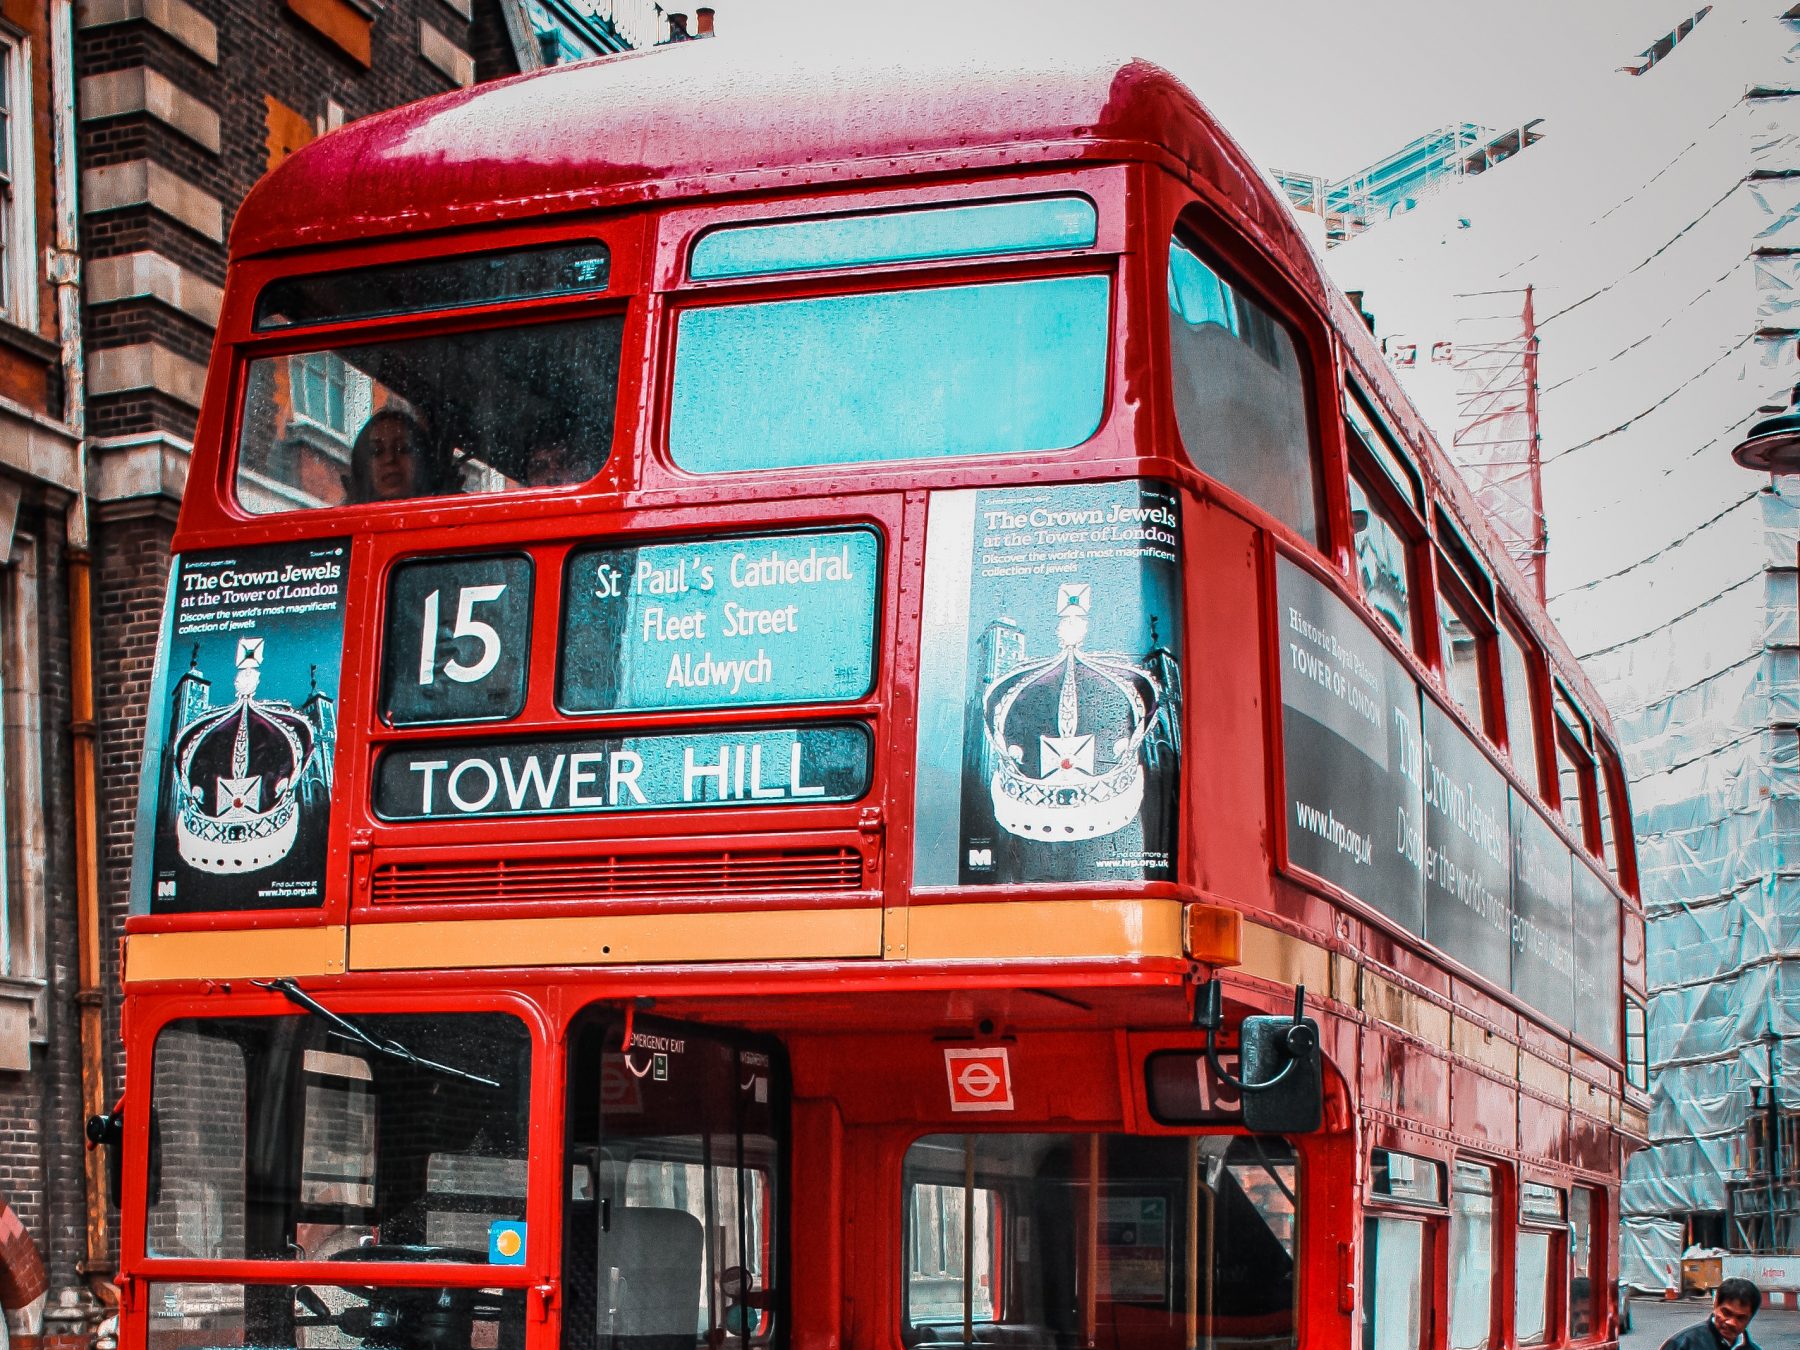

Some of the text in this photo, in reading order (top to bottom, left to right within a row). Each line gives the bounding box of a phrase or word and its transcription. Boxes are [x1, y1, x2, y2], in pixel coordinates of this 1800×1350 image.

[983, 504, 1176, 530] The Crown Jewels
[983, 526, 1176, 548] at the Tower of London
[982, 546, 1176, 565] Discover the world's most magnificent
[183, 562, 340, 592] The Crown Jewels
[595, 544, 852, 599] St Paul's Cathedral
[981, 563, 1078, 577] collection of jewels
[181, 583, 338, 608] at the Tower of London
[180, 601, 337, 623] Discover the world's most magnificent
[643, 600, 799, 642] Fleet Street
[179, 619, 255, 635] collection of jewels
[418, 584, 507, 686] 15
[1289, 607, 1331, 652] Historic
[665, 648, 772, 695] Aldwych
[1289, 642, 1381, 728] TOWER OF LONDON
[409, 742, 826, 814] TOWER HILL
[1424, 738, 1466, 832] Crown
[1296, 801, 1373, 866] www.hrp.org.uk
[1095, 858, 1169, 868] www.hrp.org.uk
[258, 887, 318, 897] www.hrp.org.uk
[671, 1039, 684, 1053] EXIT
